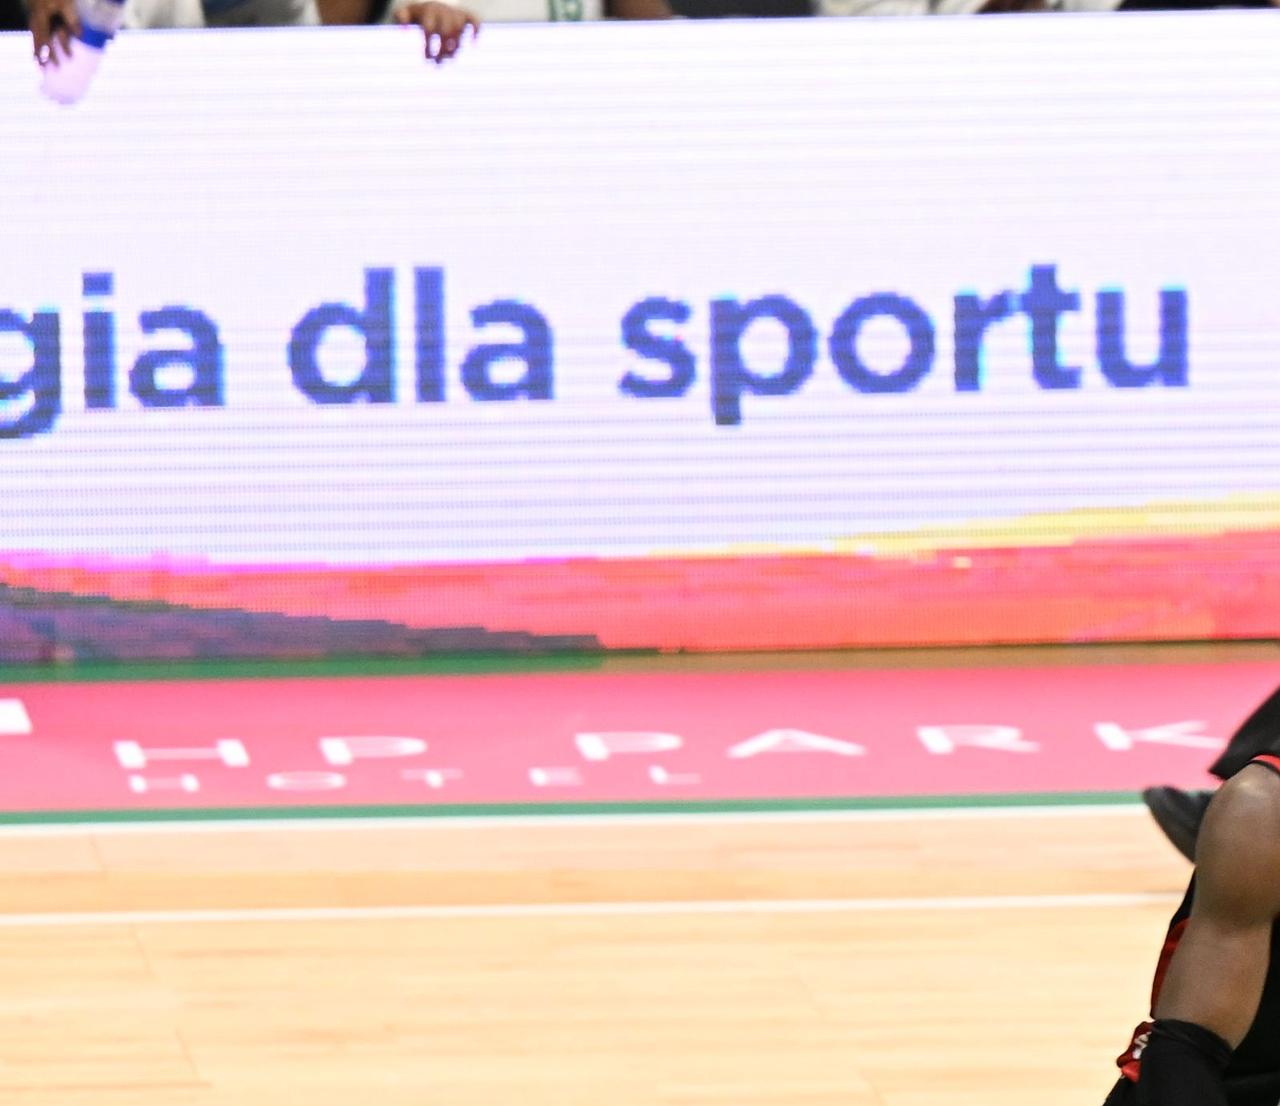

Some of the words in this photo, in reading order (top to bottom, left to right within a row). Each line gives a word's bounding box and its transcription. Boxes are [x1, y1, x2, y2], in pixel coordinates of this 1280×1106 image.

[288, 265, 557, 405] dla
[618, 262, 1191, 427] sportu
[113, 737, 428, 769] HP
[575, 721, 1227, 760] PARK
[129, 765, 700, 793] HOTEL
